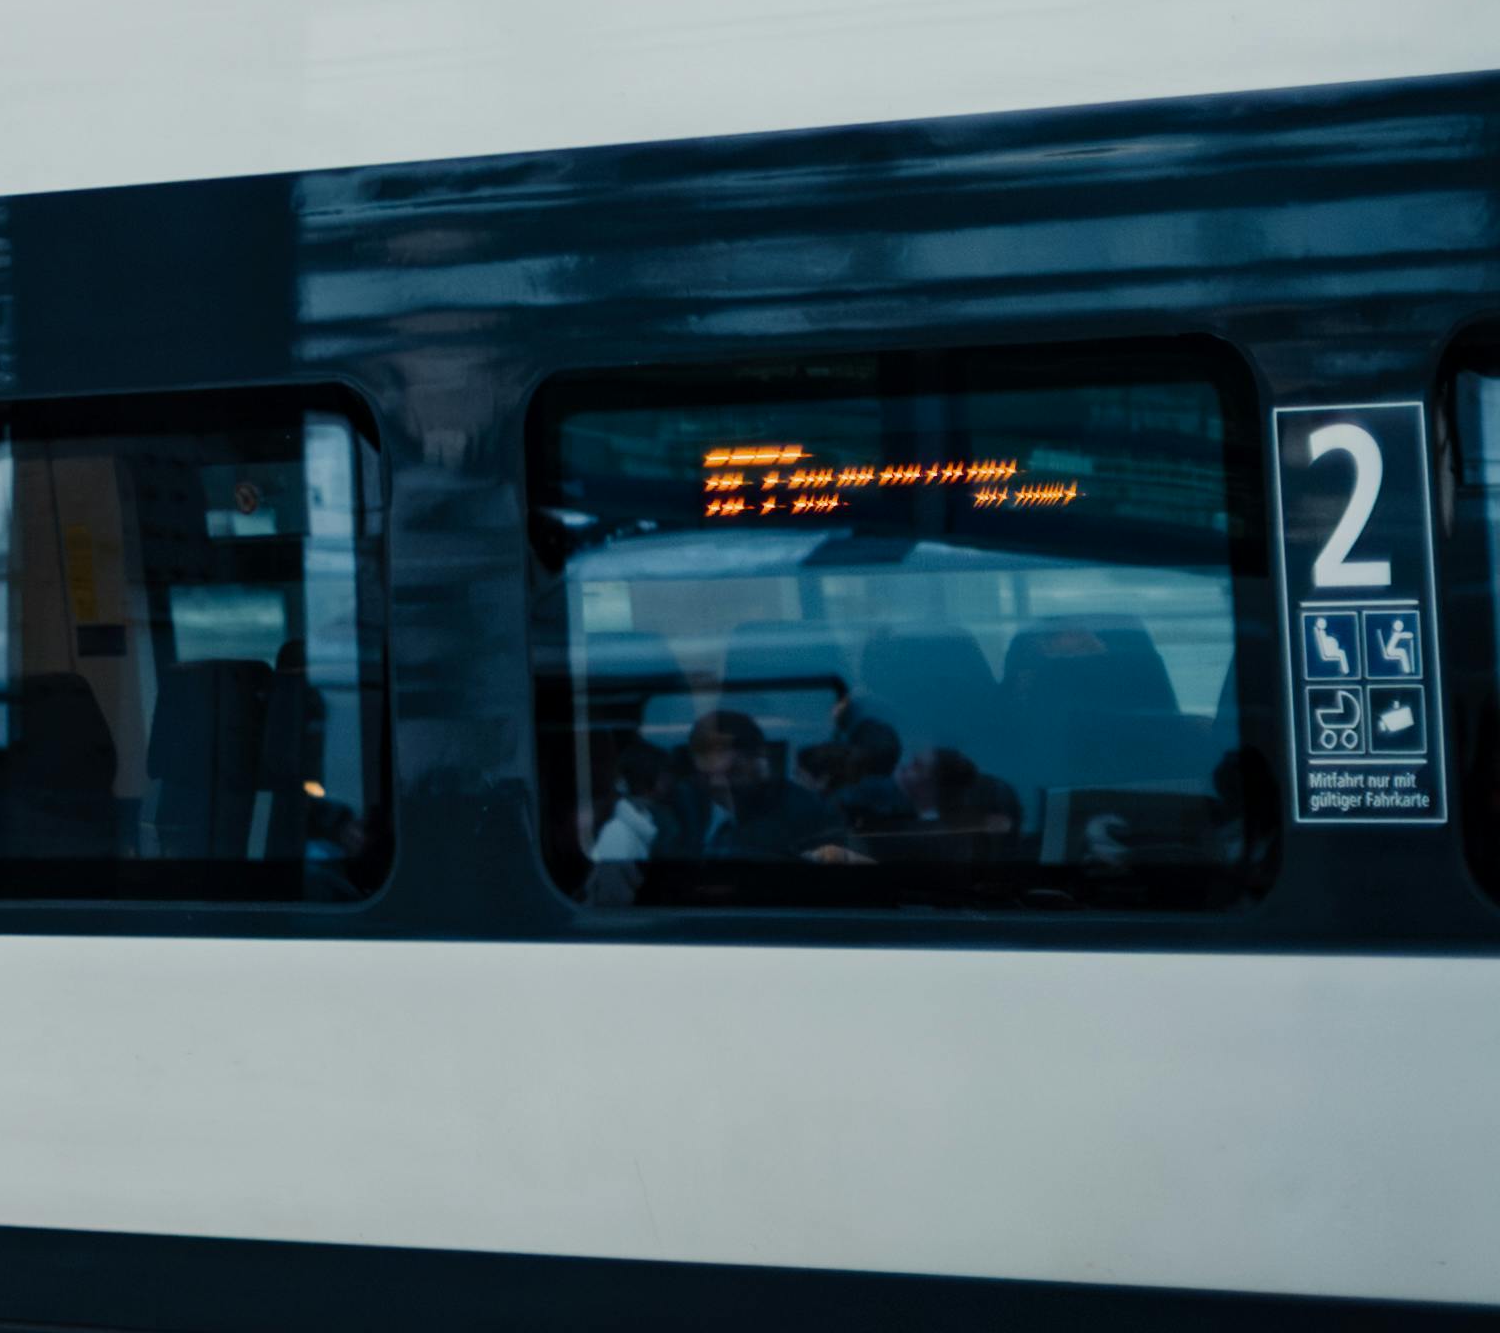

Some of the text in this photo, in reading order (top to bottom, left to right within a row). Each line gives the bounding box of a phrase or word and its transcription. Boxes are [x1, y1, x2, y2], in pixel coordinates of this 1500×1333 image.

[1309, 423, 1392, 587] 2
[1308, 772, 1417, 788] Mitfahrt nur mit
[1310, 791, 1430, 812] gültiger Fahrkarte
